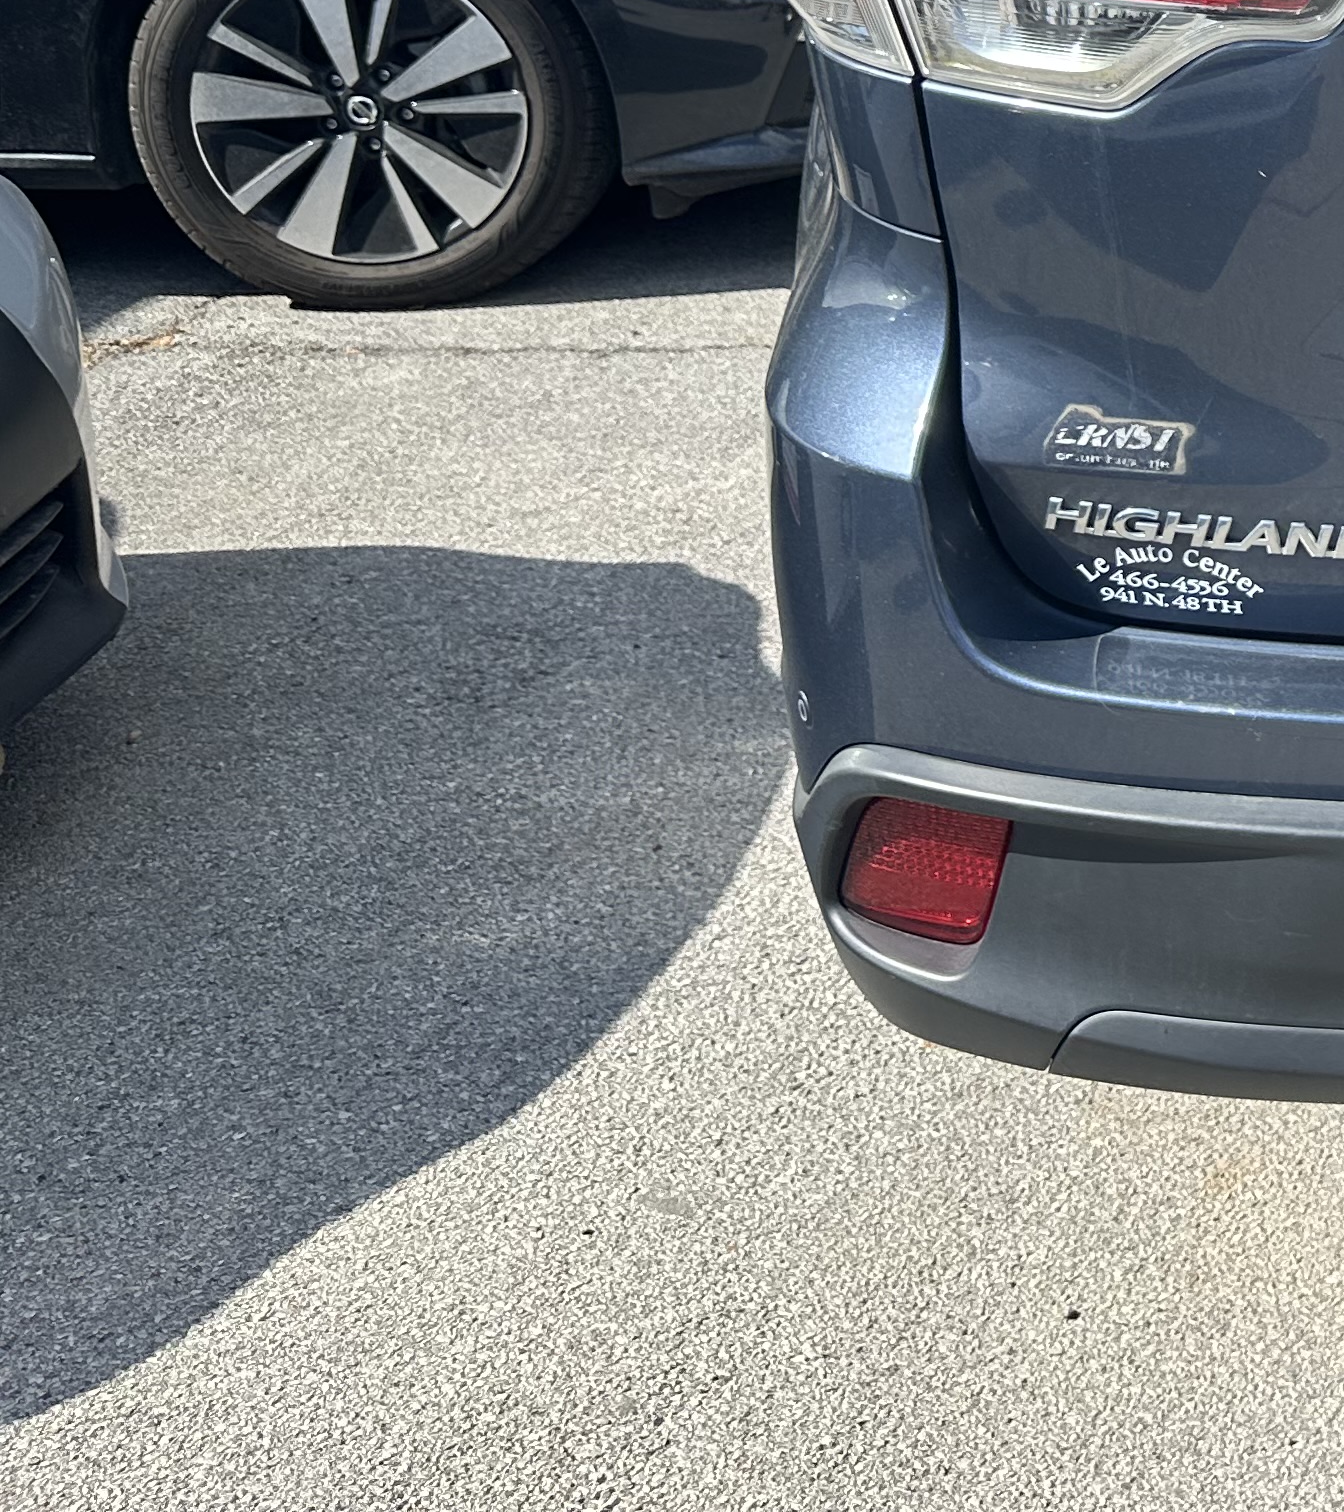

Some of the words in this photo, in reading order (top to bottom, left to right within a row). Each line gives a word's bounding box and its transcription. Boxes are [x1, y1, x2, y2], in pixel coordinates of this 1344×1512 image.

[1076, 556, 1110, 583] Le
[1114, 544, 1173, 567] Auto
[1183, 549, 1265, 599] Center
[1109, 569, 1230, 596] 466-4556
[1100, 587, 1138, 604] 941
[1142, 591, 1170, 608] N.
[1172, 595, 1244, 615] 48TH
